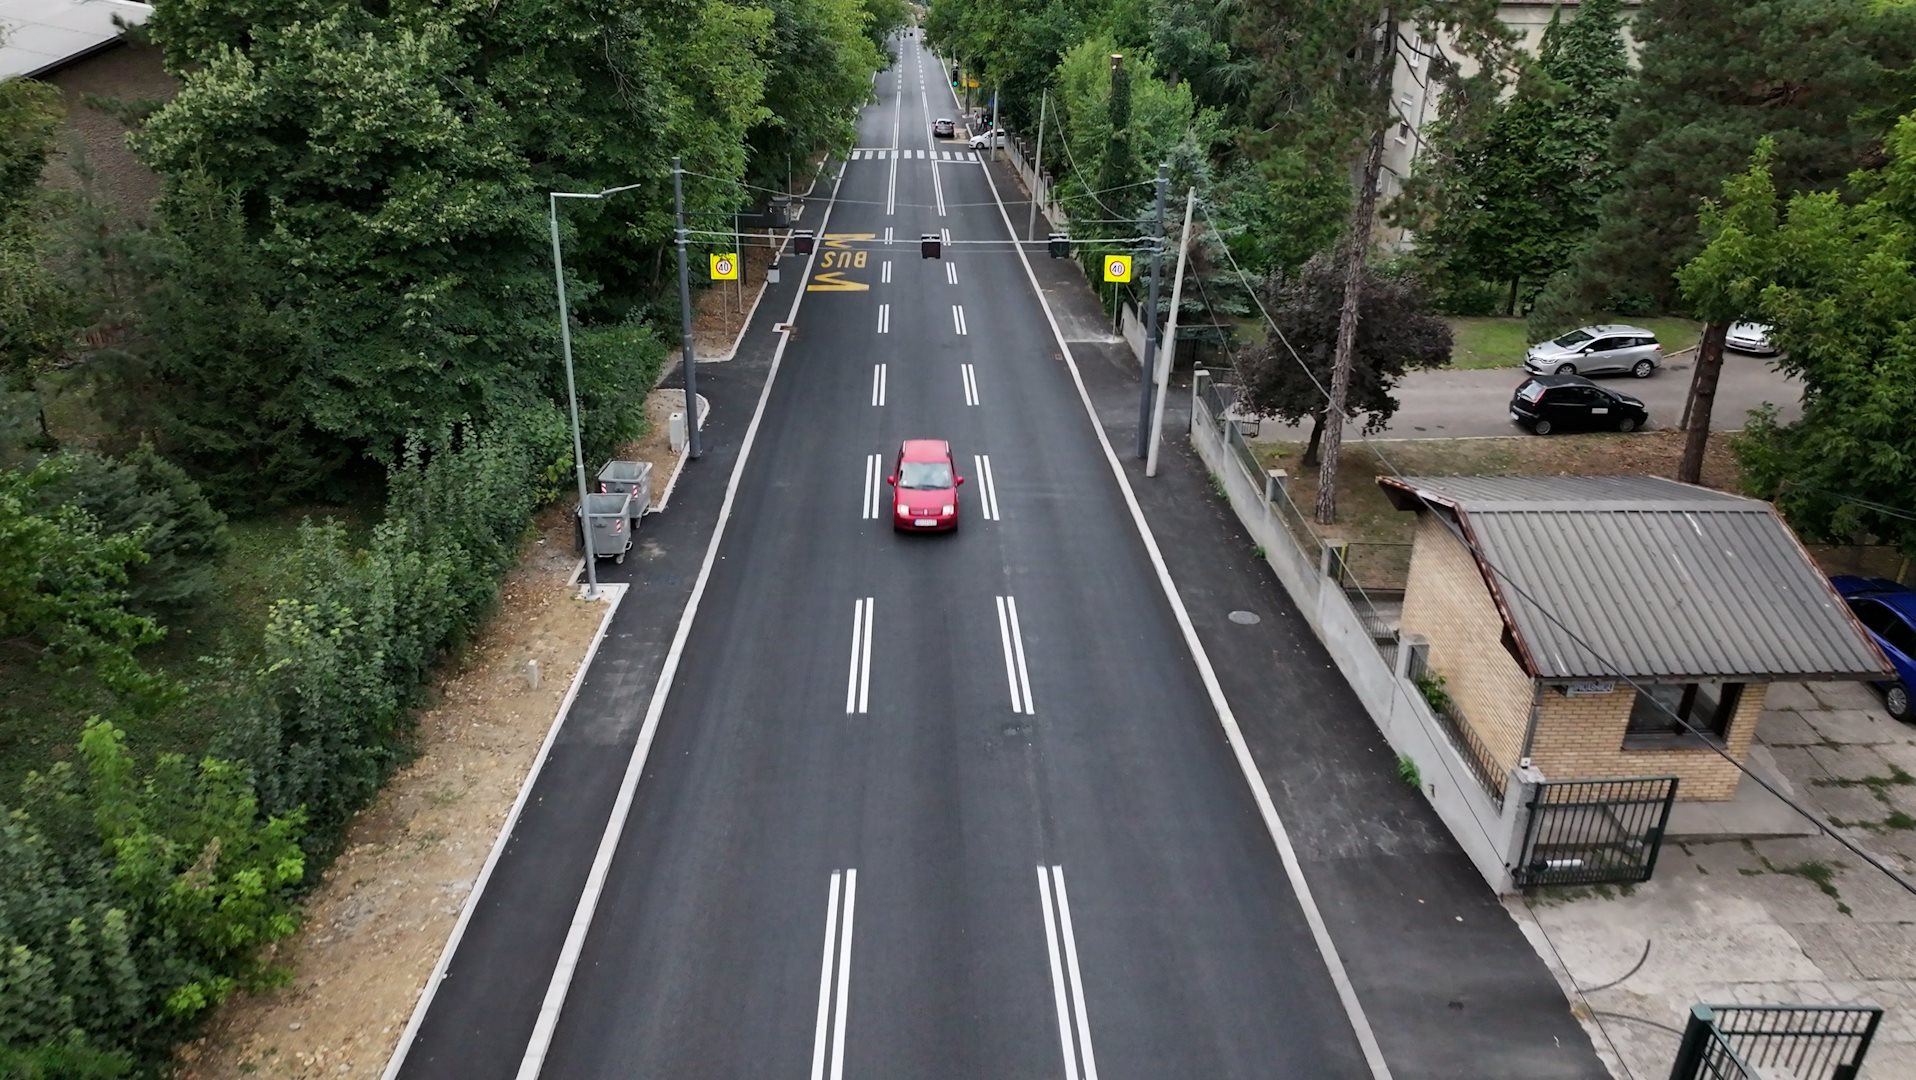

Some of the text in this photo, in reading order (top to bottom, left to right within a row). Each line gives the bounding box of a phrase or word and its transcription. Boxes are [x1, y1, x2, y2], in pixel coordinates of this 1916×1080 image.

[821, 251, 867, 268] BUS
[719, 262, 728, 271] 40
[1112, 265, 1122, 273] 40
